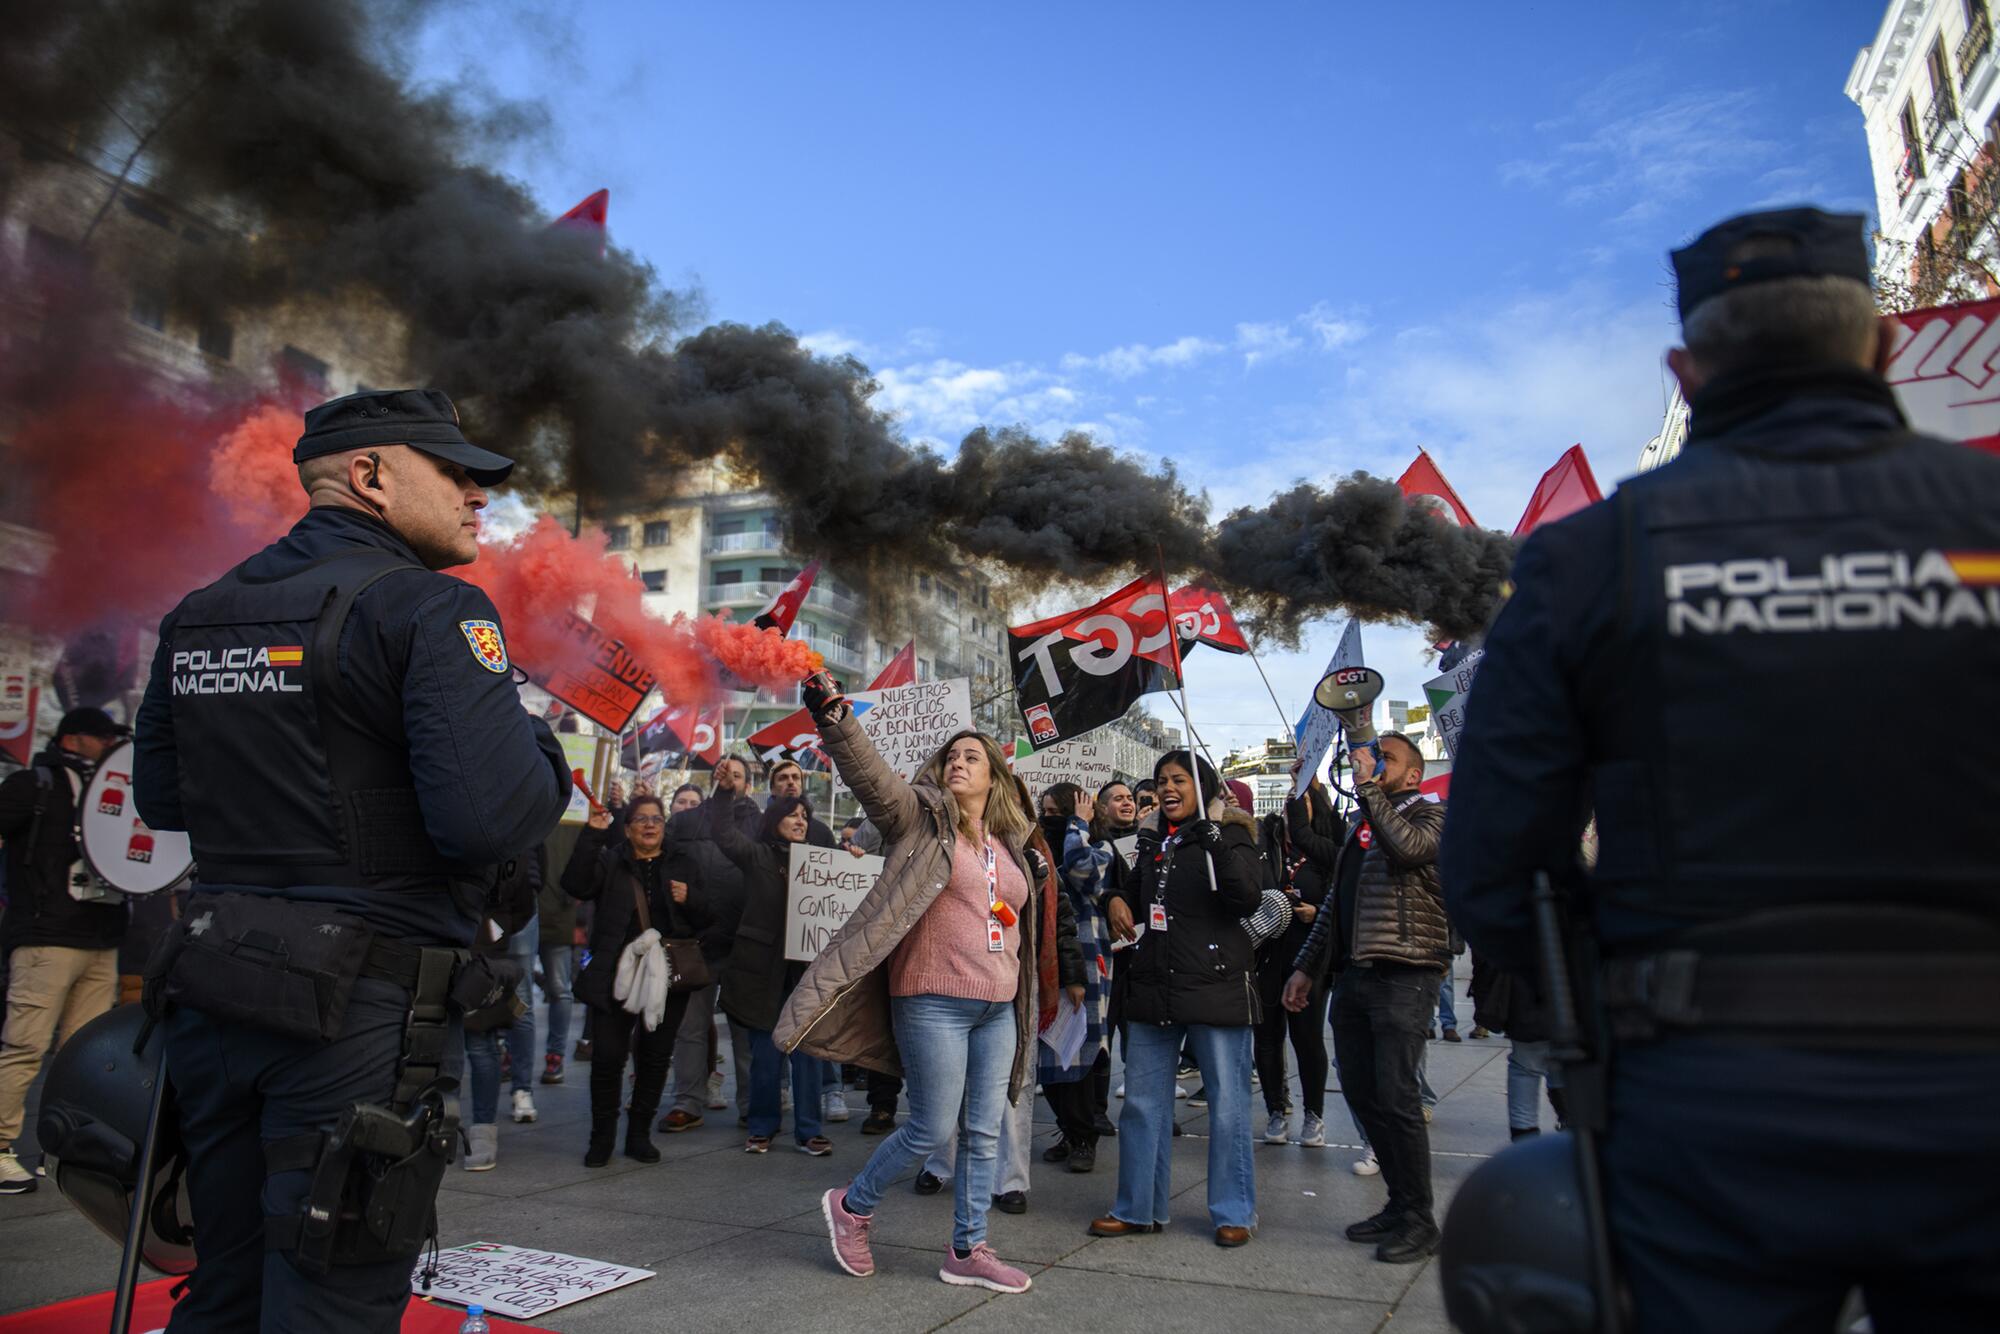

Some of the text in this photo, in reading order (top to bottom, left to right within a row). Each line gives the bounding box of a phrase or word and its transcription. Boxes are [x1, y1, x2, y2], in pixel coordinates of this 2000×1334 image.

[172, 670, 303, 697] NACIONAL
[1337, 670, 1367, 684] CGT
[881, 682, 951, 704] NUESTROS
[865, 721, 881, 737] SUS
[891, 737, 900, 750] A
[1081, 745, 1097, 757] EN
[893, 751, 901, 766] Y
[1041, 754, 1071, 770] LUCHA
[100, 802, 122, 815] CGT
[127, 848, 151, 862] CGT
[795, 861, 869, 892] ALBACETE
[798, 894, 853, 922] CONTRA
[481, 1273, 571, 1297] GRATIS
